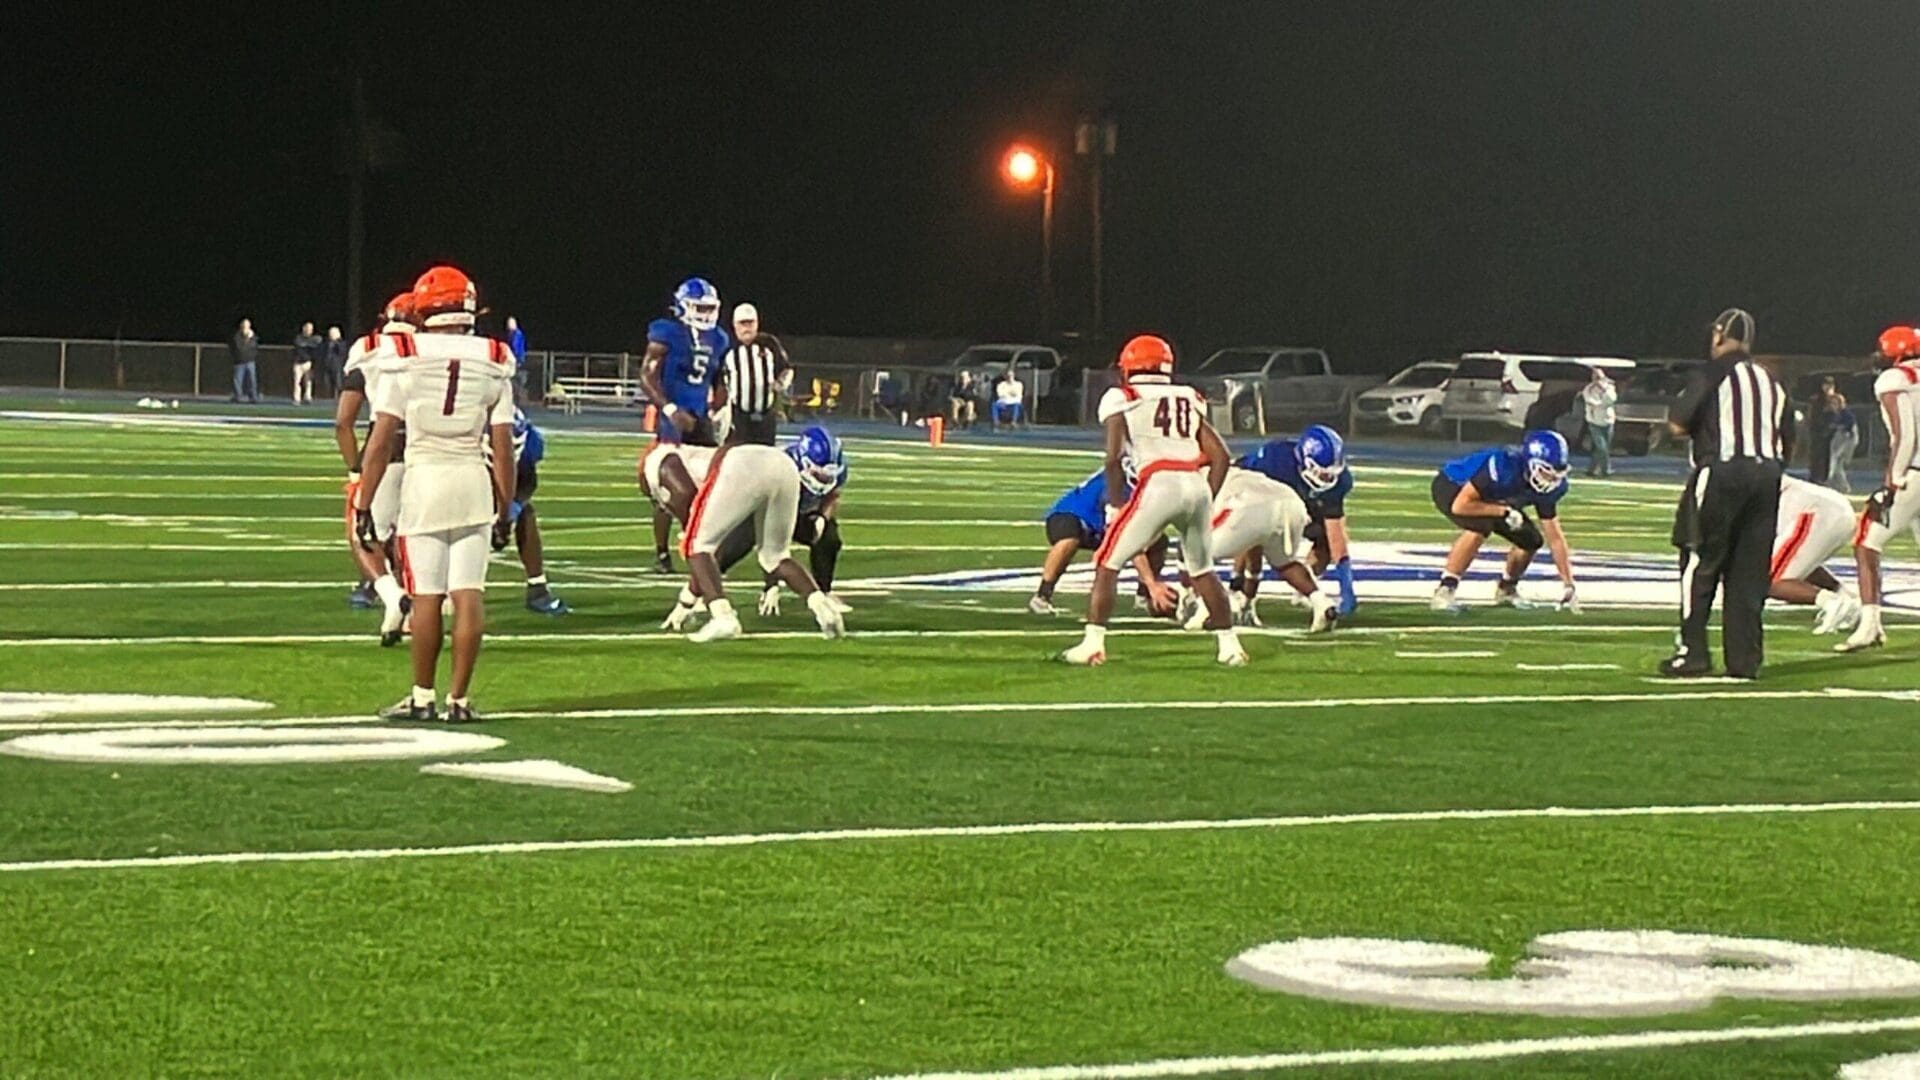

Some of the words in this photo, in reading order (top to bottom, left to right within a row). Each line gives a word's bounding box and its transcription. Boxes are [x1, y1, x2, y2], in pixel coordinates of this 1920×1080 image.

[443, 358, 460, 416] 1
[688, 355, 709, 384] 5
[1153, 396, 1191, 438] 40
